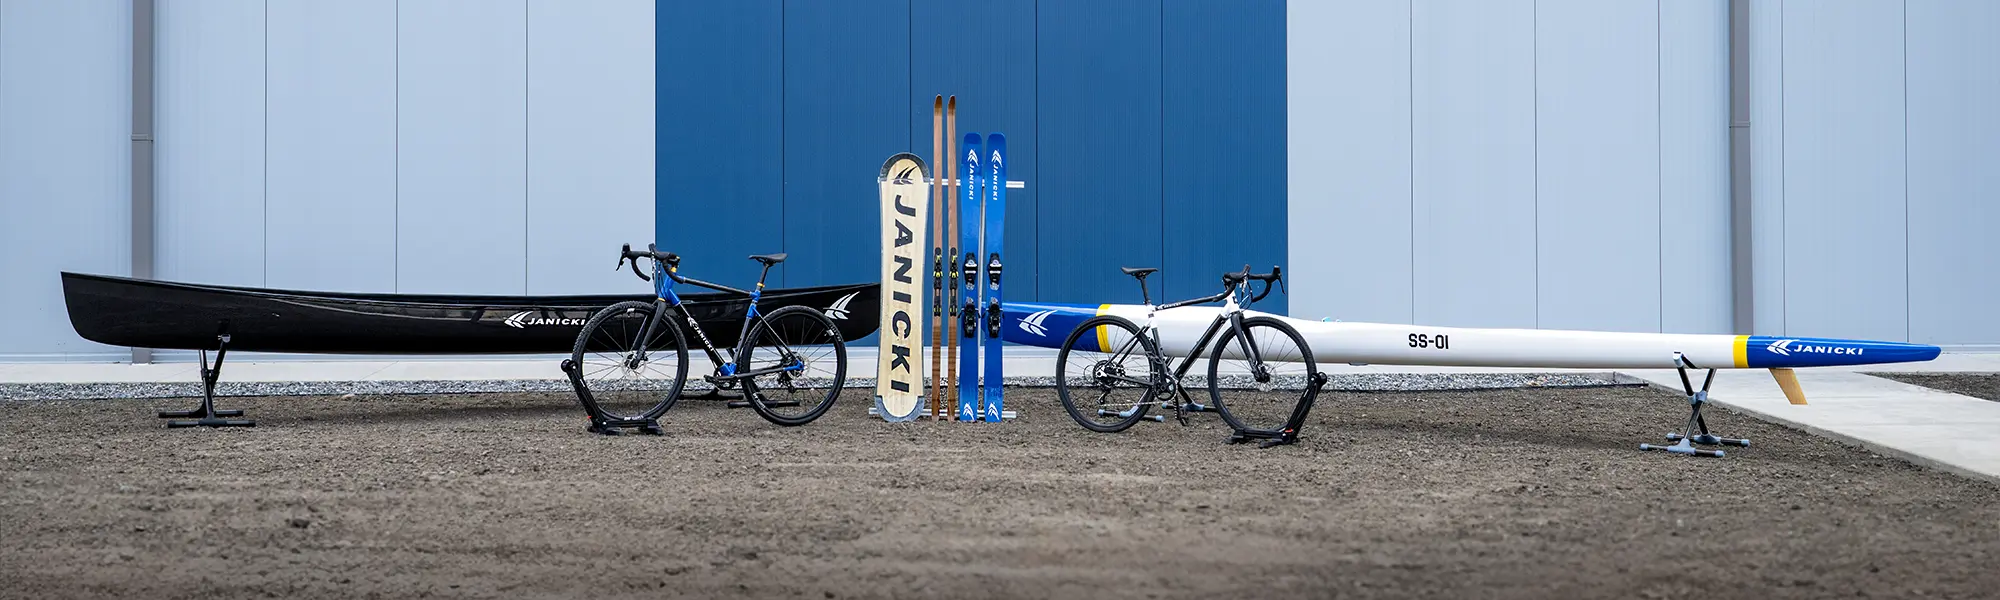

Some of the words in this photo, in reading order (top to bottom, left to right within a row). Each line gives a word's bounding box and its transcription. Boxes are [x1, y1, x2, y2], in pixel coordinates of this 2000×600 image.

[891, 195, 916, 394] JANICKI
[527, 318, 586, 326] JANICKI
[1793, 344, 1864, 355] JANICKI
